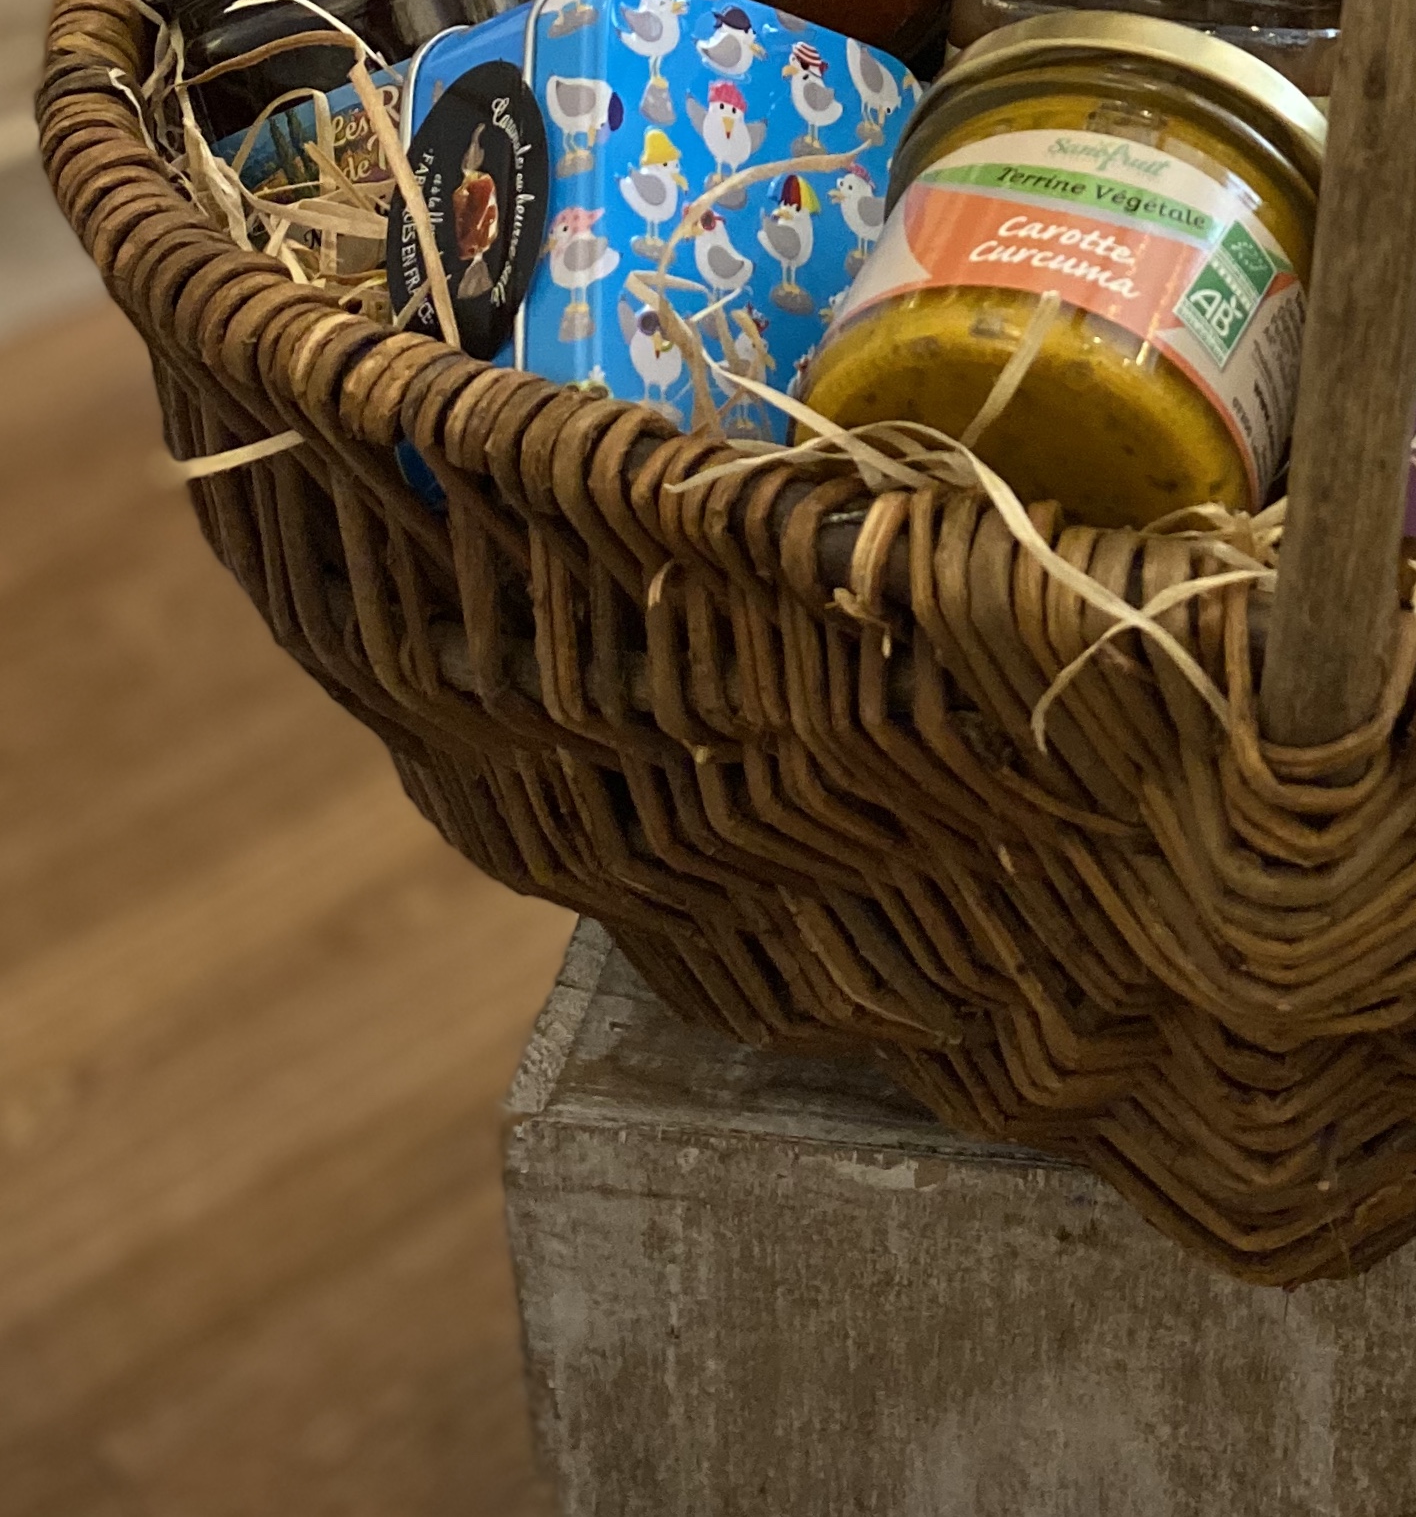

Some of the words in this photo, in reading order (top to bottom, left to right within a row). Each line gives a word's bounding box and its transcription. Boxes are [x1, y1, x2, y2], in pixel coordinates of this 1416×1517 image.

[997, 165, 1088, 196] Terrine
[1094, 182, 1206, 230] Végétale
[400, 246, 417, 269] EN
[997, 215, 1136, 266] Carotte
[968, 239, 1141, 300] Curcuma
[1190, 288, 1235, 338] AB
